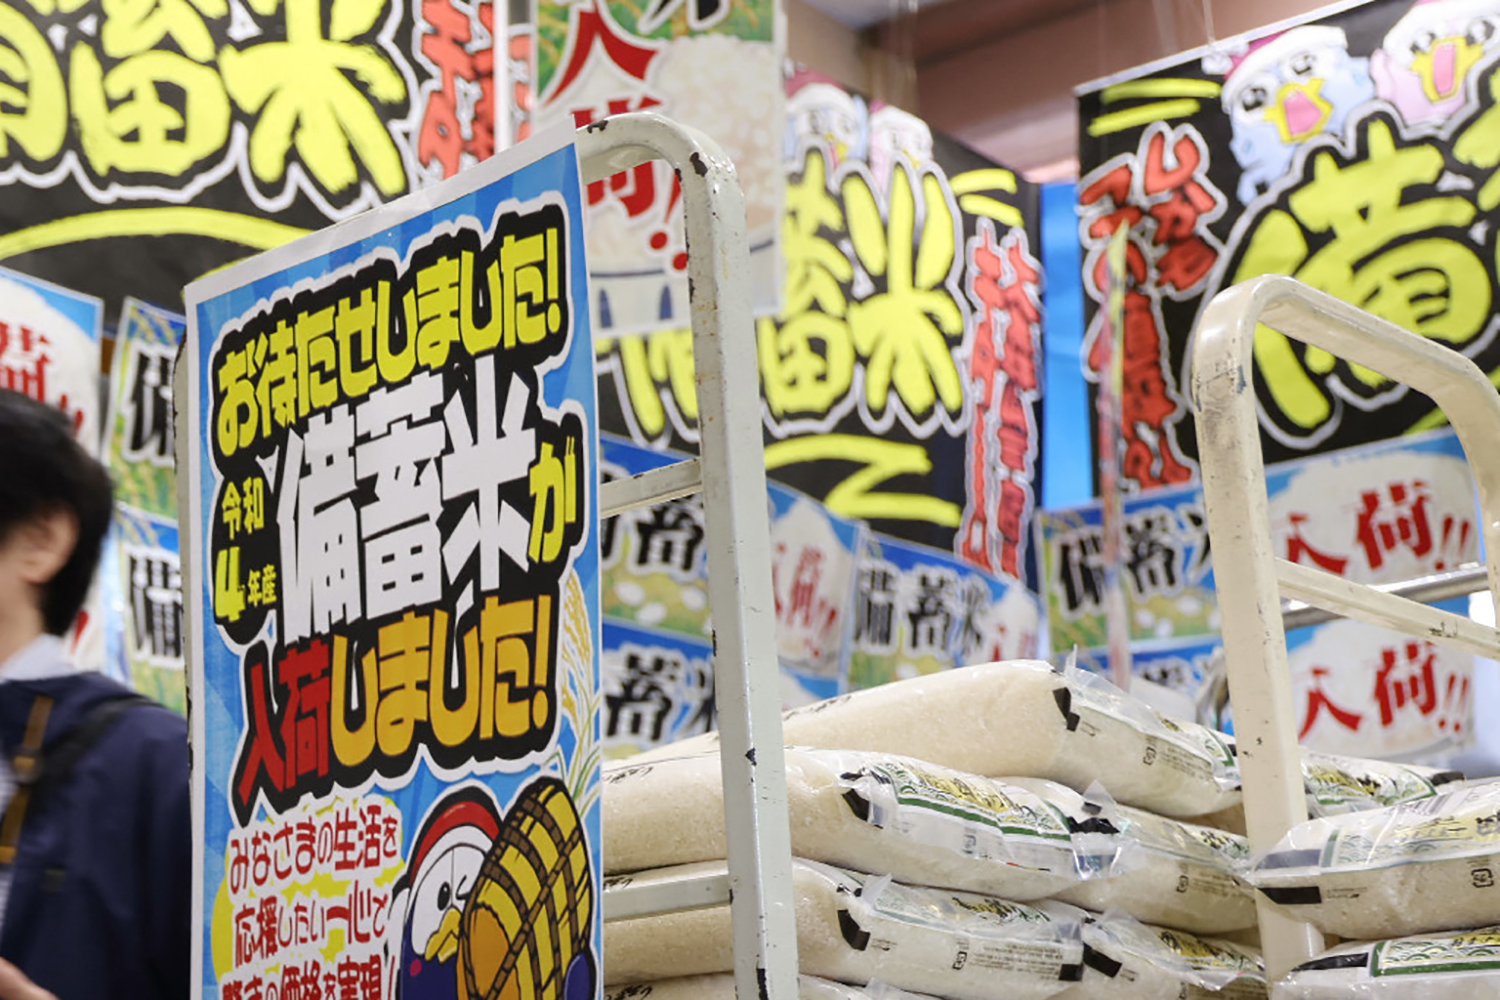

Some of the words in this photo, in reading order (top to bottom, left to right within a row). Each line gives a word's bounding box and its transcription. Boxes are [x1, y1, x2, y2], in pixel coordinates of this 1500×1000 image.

[221, 476, 265, 541] 令和
[229, 803, 398, 894] みなさまの生活を
[235, 879, 388, 968] 応援したい一心で
